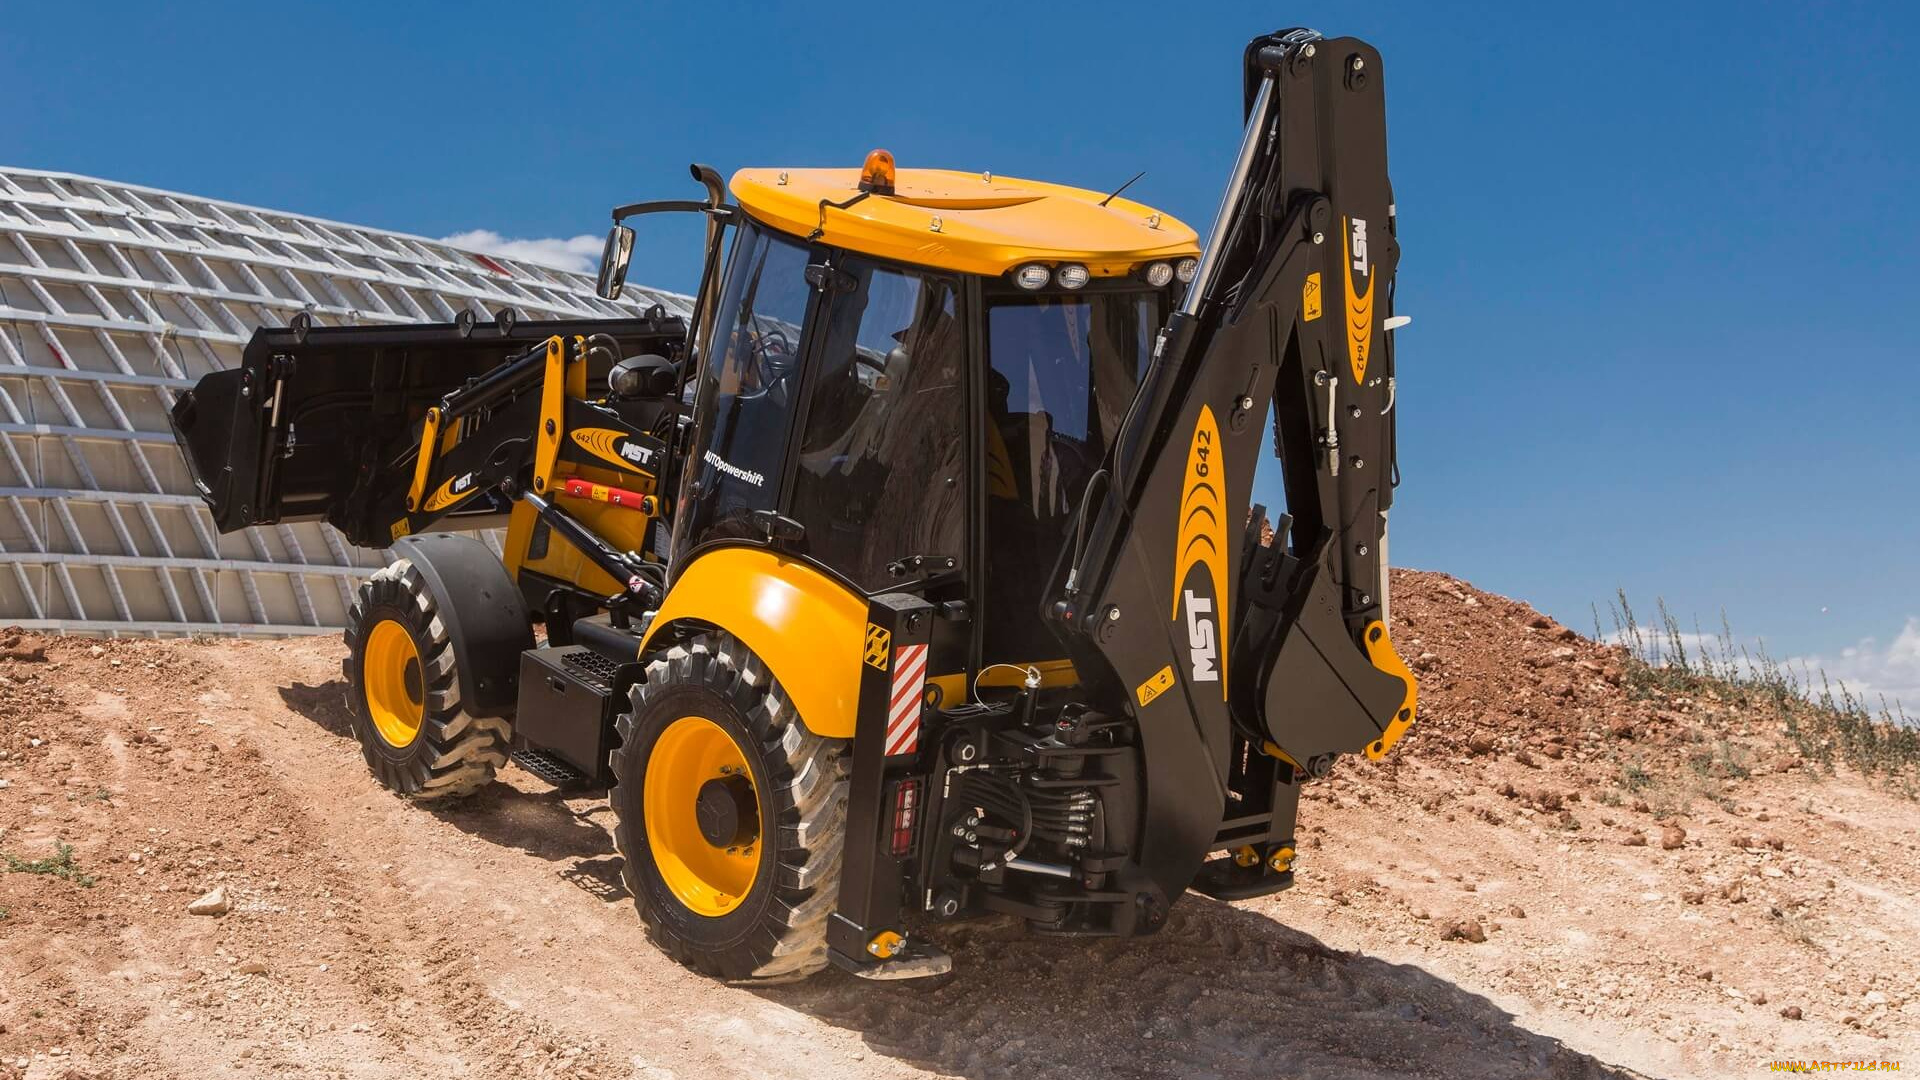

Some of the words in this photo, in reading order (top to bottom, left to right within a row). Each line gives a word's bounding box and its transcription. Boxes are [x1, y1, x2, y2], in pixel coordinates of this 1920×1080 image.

[1351, 218, 1368, 276] MST
[1357, 345, 1365, 371] 642
[576, 433, 591, 444] 642
[620, 441, 653, 464] MST
[1196, 429, 1211, 477] 642
[455, 472, 472, 492] MST
[704, 450, 764, 487] AUTOpowershift
[1184, 589, 1218, 682] MST
